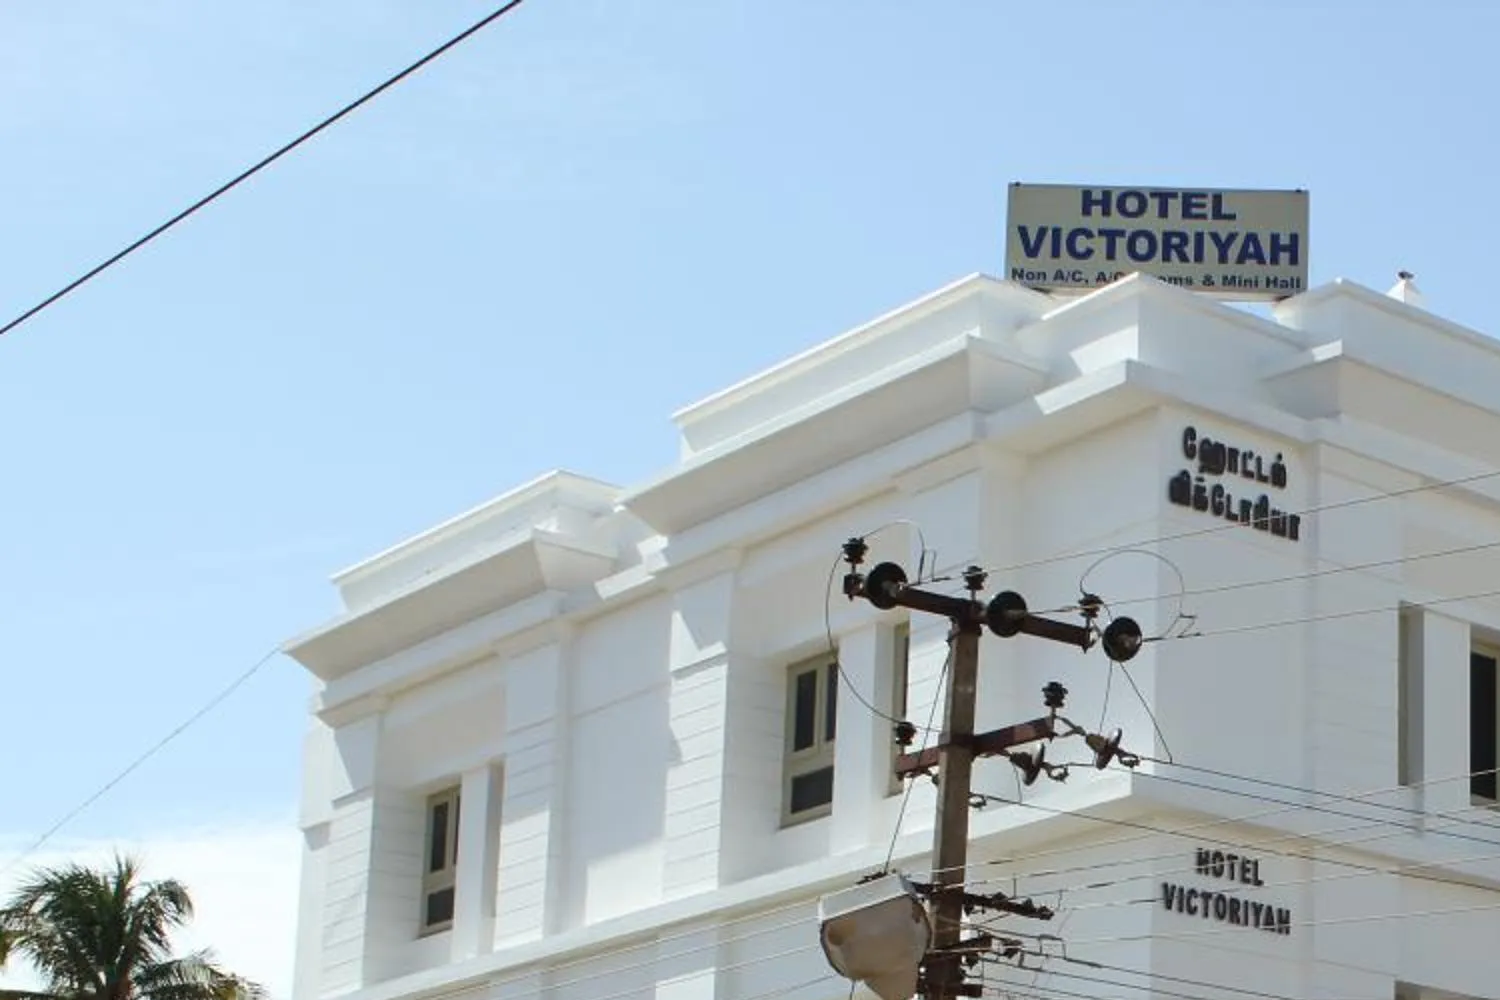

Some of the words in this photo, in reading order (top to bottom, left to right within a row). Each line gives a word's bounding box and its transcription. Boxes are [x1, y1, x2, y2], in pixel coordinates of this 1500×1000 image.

[1081, 189, 1236, 220] HOTEL
[1017, 225, 1299, 265] VICTORIYAH
[1011, 268, 1047, 282] Non
[1053, 269, 1089, 284] A/C,
[1202, 274, 1215, 287] &
[1222, 275, 1260, 288] Mini
[1265, 276, 1301, 289] Hall
[1196, 847, 1264, 886] HOTEL
[1161, 882, 1291, 935] VICTORIYAH
